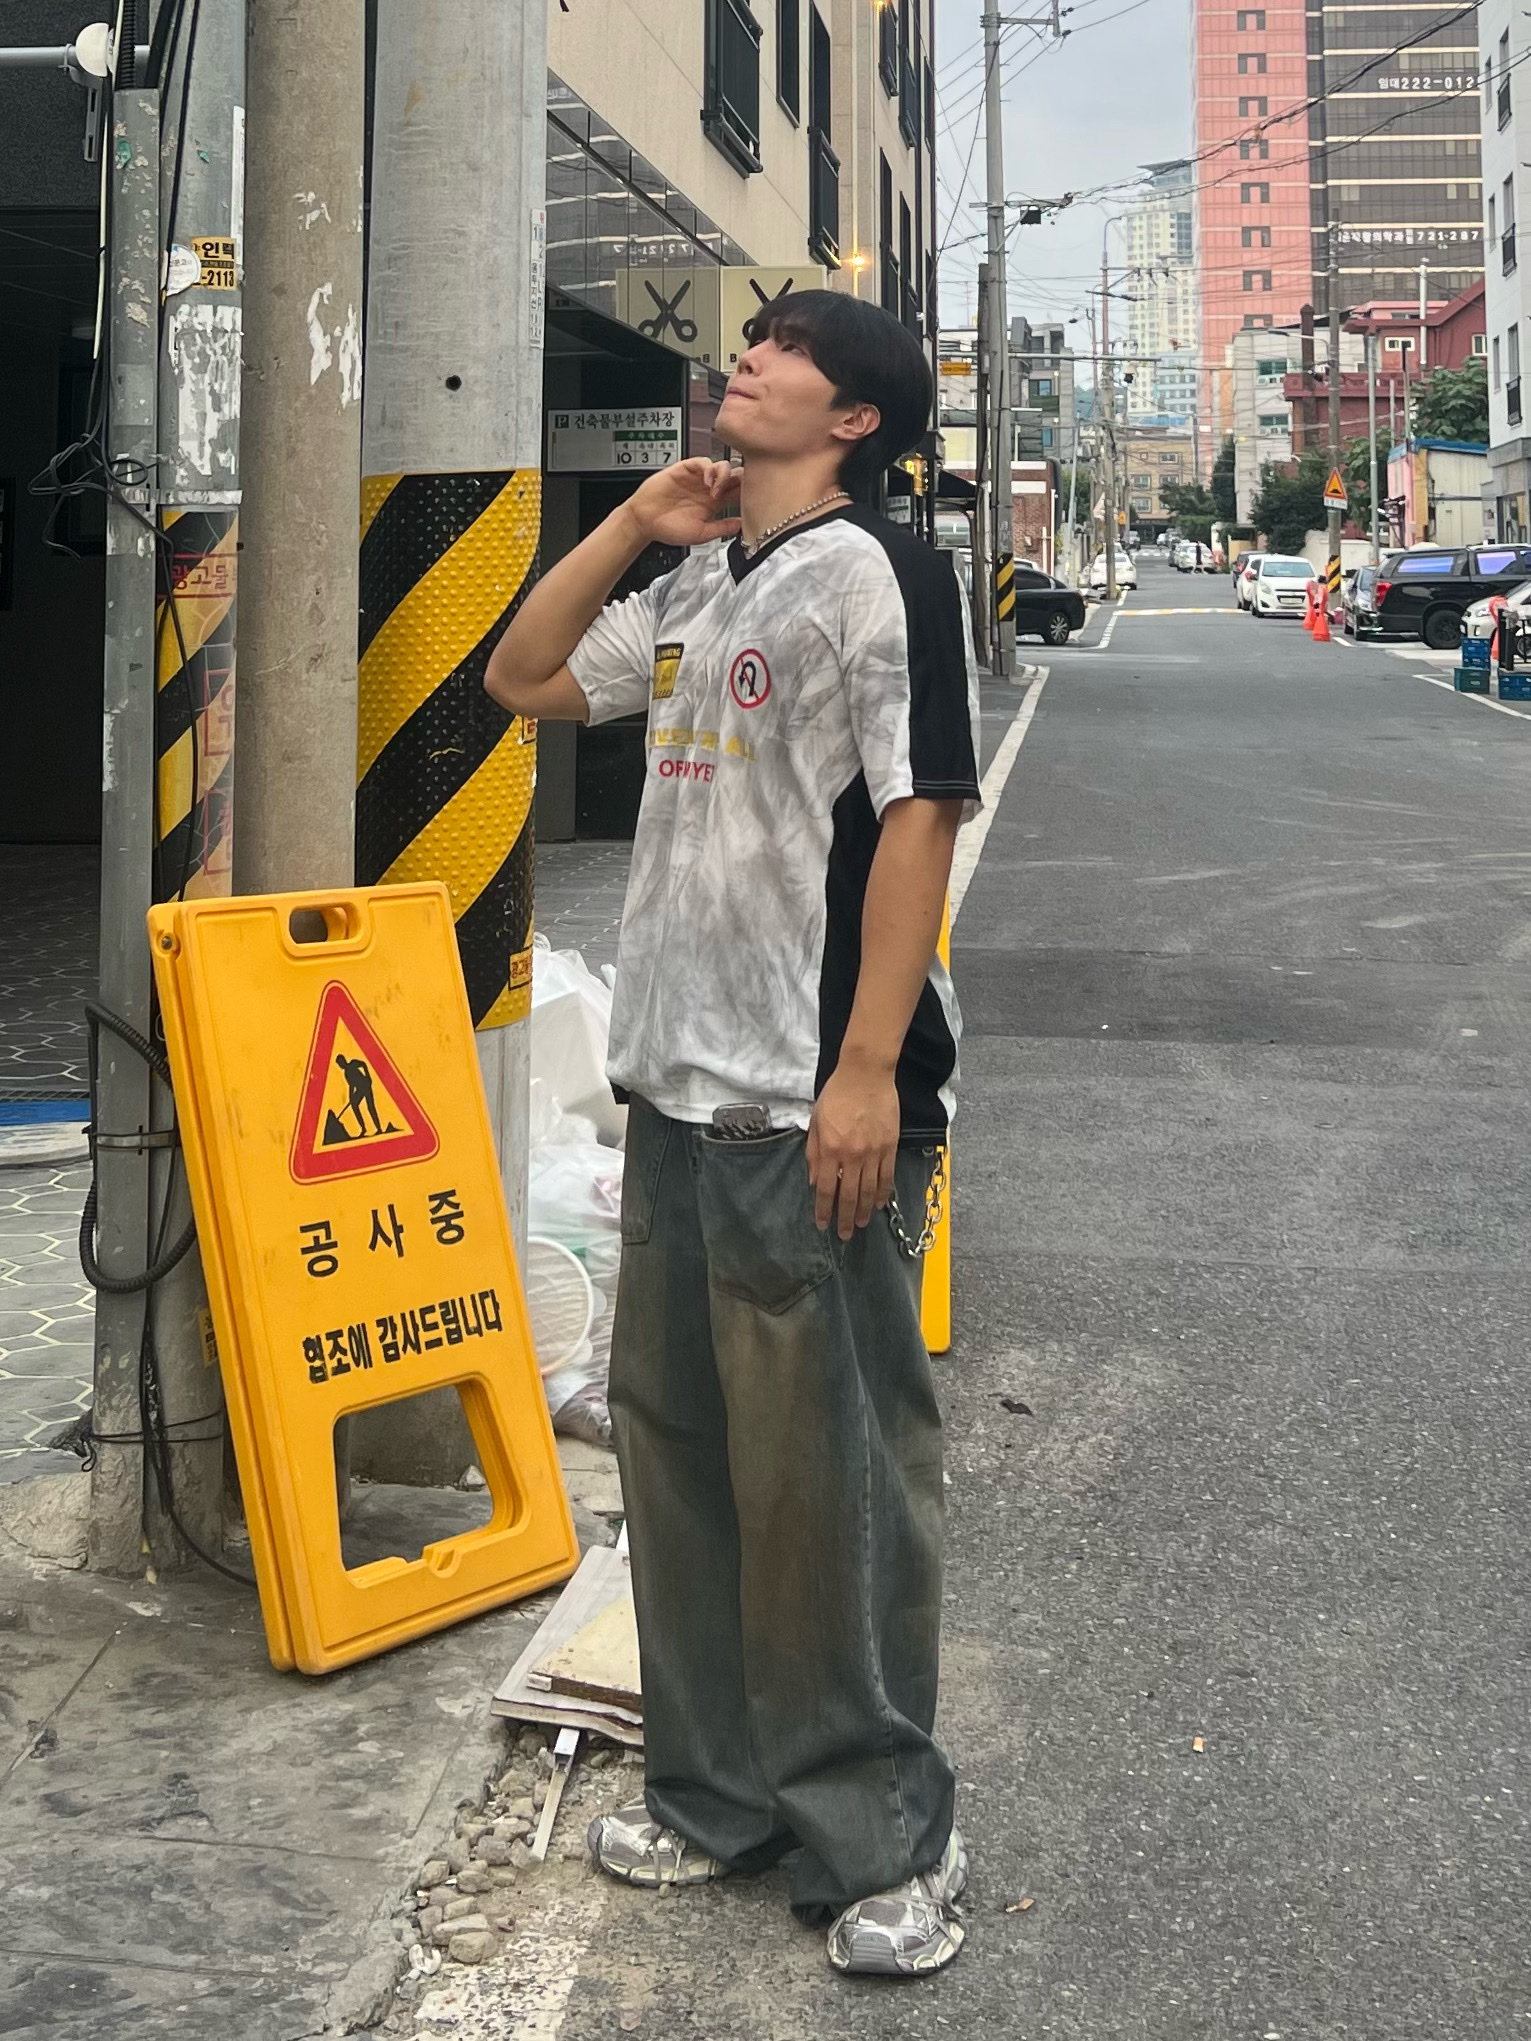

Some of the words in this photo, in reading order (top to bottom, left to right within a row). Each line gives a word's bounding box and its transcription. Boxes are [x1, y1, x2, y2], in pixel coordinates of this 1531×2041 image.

[574, 411, 675, 429] 건축물부설주차장
[617, 452, 632, 465] 10
[641, 452, 649, 463] 3
[663, 452, 671, 463] 7
[302, 1322, 373, 1384] 협조에
[376, 1288, 503, 1363] 감사드립니다
